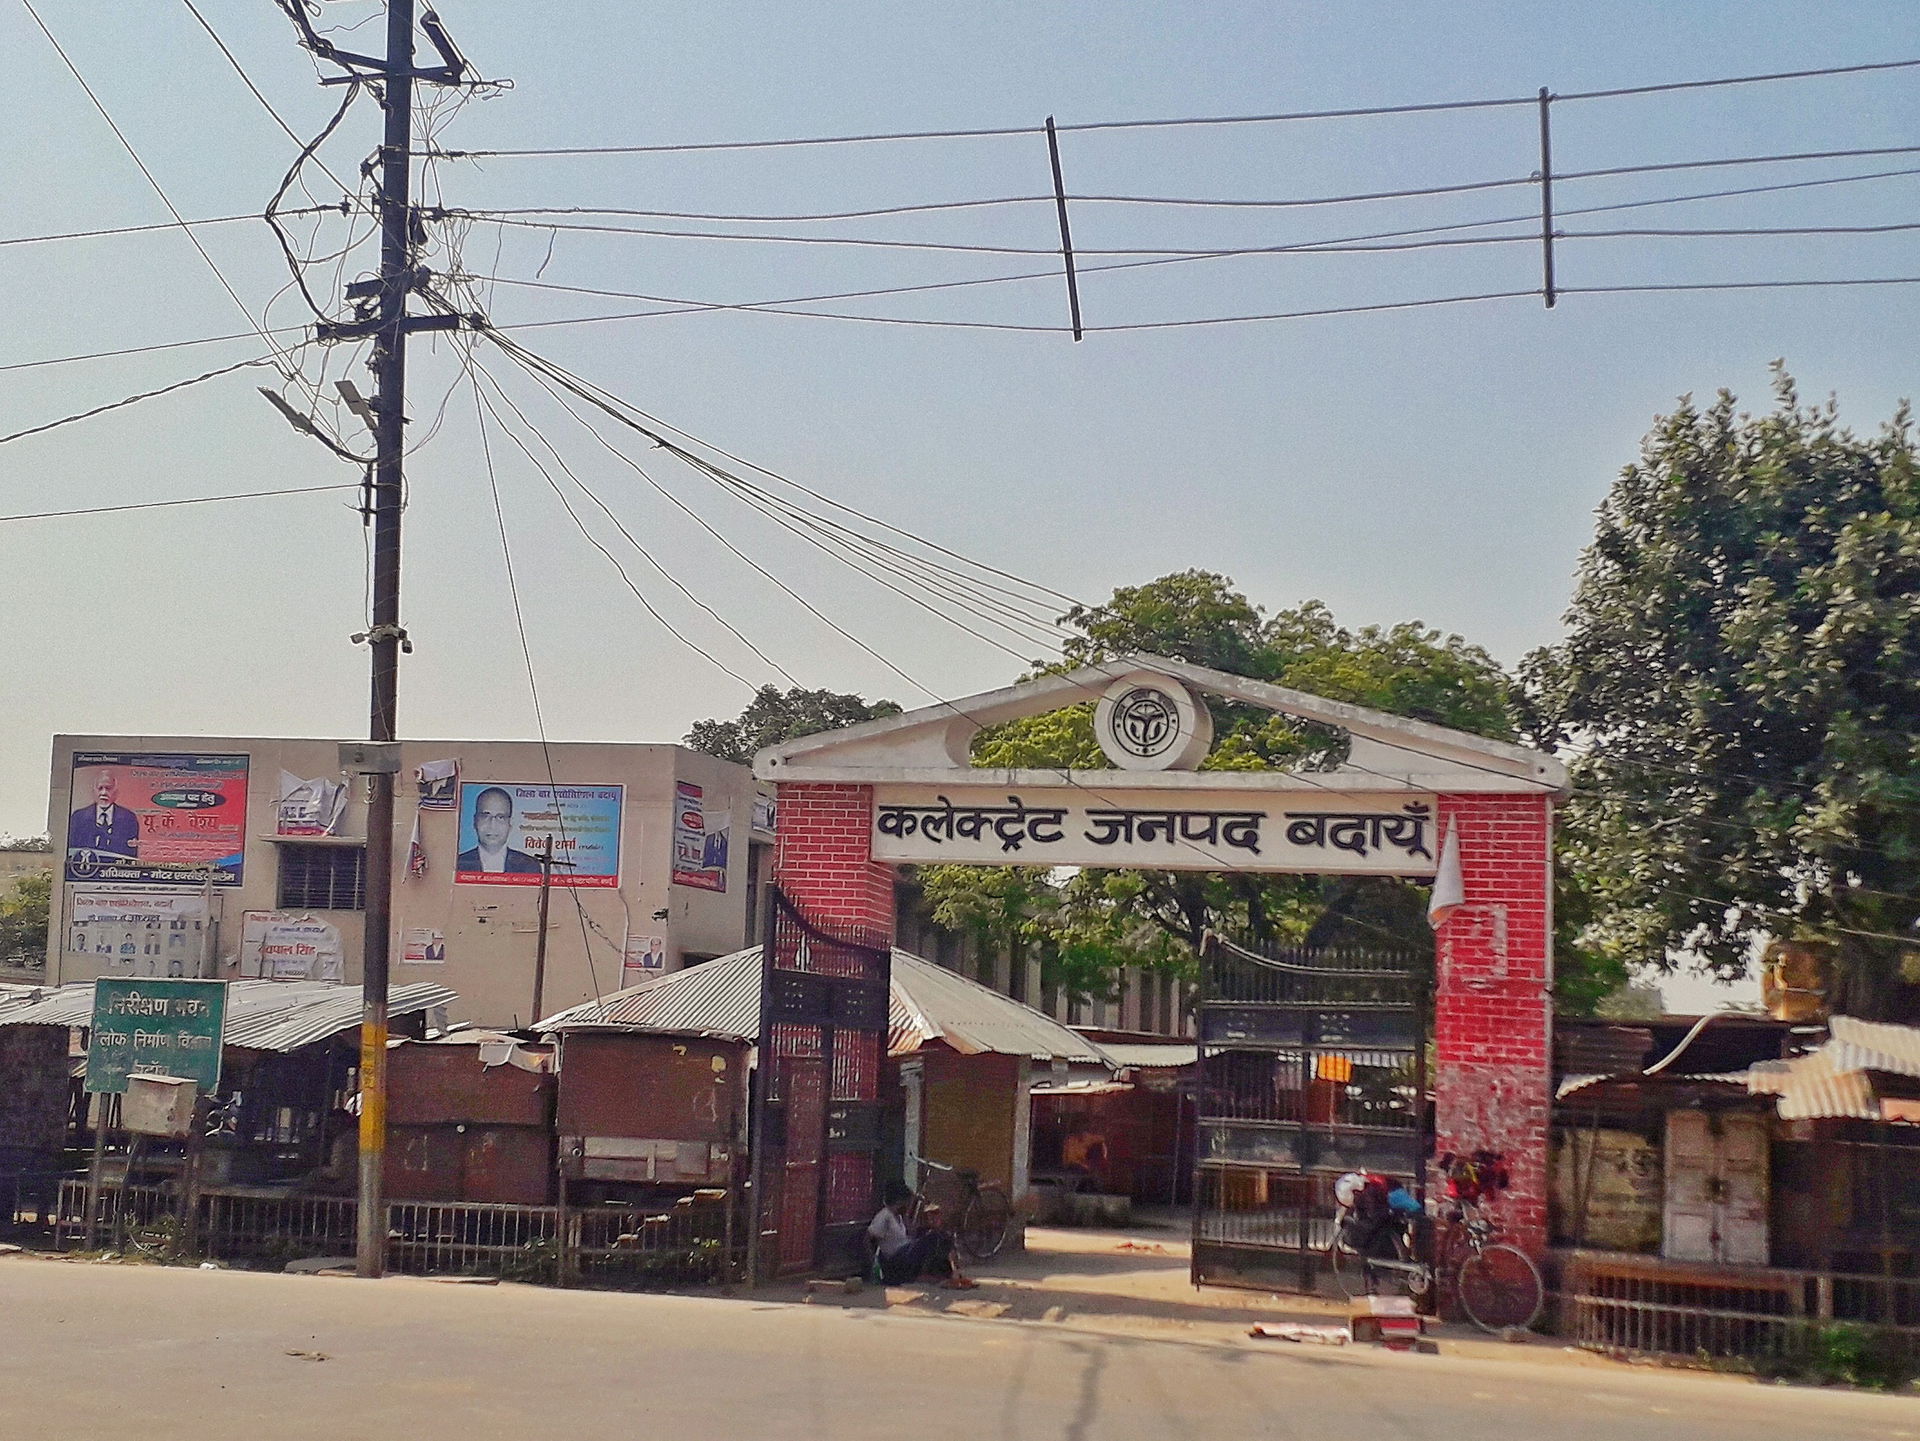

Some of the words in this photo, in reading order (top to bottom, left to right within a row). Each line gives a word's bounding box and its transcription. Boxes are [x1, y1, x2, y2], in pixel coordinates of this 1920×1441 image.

[878, 795, 1068, 851] कलेक्ट्रेट
[1084, 808, 1268, 855] जनपद
[1284, 801, 1432, 861] बदायूँ
[97, 1028, 129, 1048] लोक
[134, 1028, 170, 1050] निर्माण
